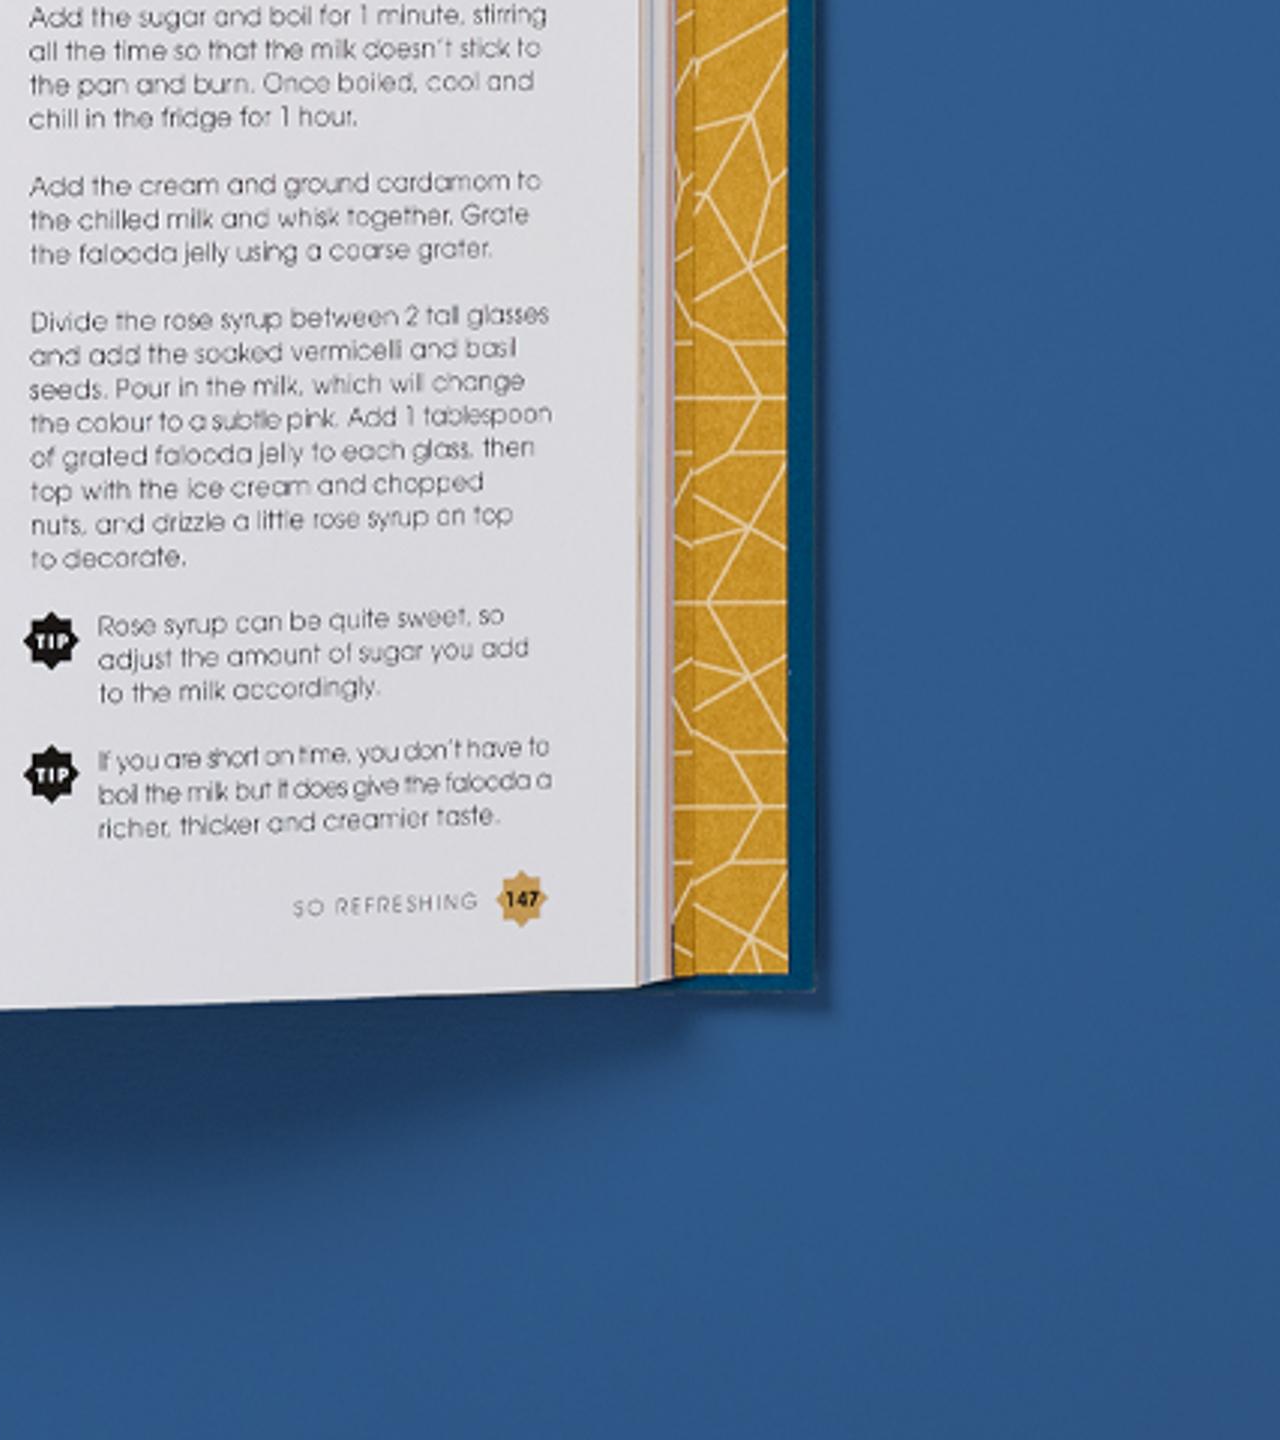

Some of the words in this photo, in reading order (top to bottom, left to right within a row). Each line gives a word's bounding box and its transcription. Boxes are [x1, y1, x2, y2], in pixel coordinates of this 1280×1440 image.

[29, 107, 79, 131] chill
[85, 107, 106, 130] in
[113, 107, 154, 131] the
[160, 104, 234, 134] fridge
[239, 105, 272, 129] for
[280, 104, 289, 128] 1
[299, 104, 357, 128] hour.
[30, 309, 108, 335] Divide
[115, 309, 157, 333] the
[164, 311, 213, 332] rose
[221, 311, 283, 336] syrup
[290, 305, 399, 331] between
[404, 303, 420, 328] 2
[425, 304, 460, 328] tall
[466, 303, 549, 331] glasses
[31, 548, 58, 572] to
[62, 545, 186, 571] decorate.
[98, 613, 157, 638] Rose
[164, 614, 228, 641] syrup
[235, 614, 283, 635] can
[290, 609, 322, 633] be
[328, 607, 390, 635] quite
[397, 606, 471, 630] sweet,
[479, 607, 505, 626] so
[36, 634, 70, 649] TIP
[36, 766, 70, 783] TIP
[179, 812, 261, 838] thicker
[266, 810, 316, 836] and
[323, 806, 429, 833] creamier
[436, 803, 501, 828] taste.
[293, 898, 324, 919] SO
[335, 890, 478, 917] REFRESHING
[506, 891, 539, 909] 147
